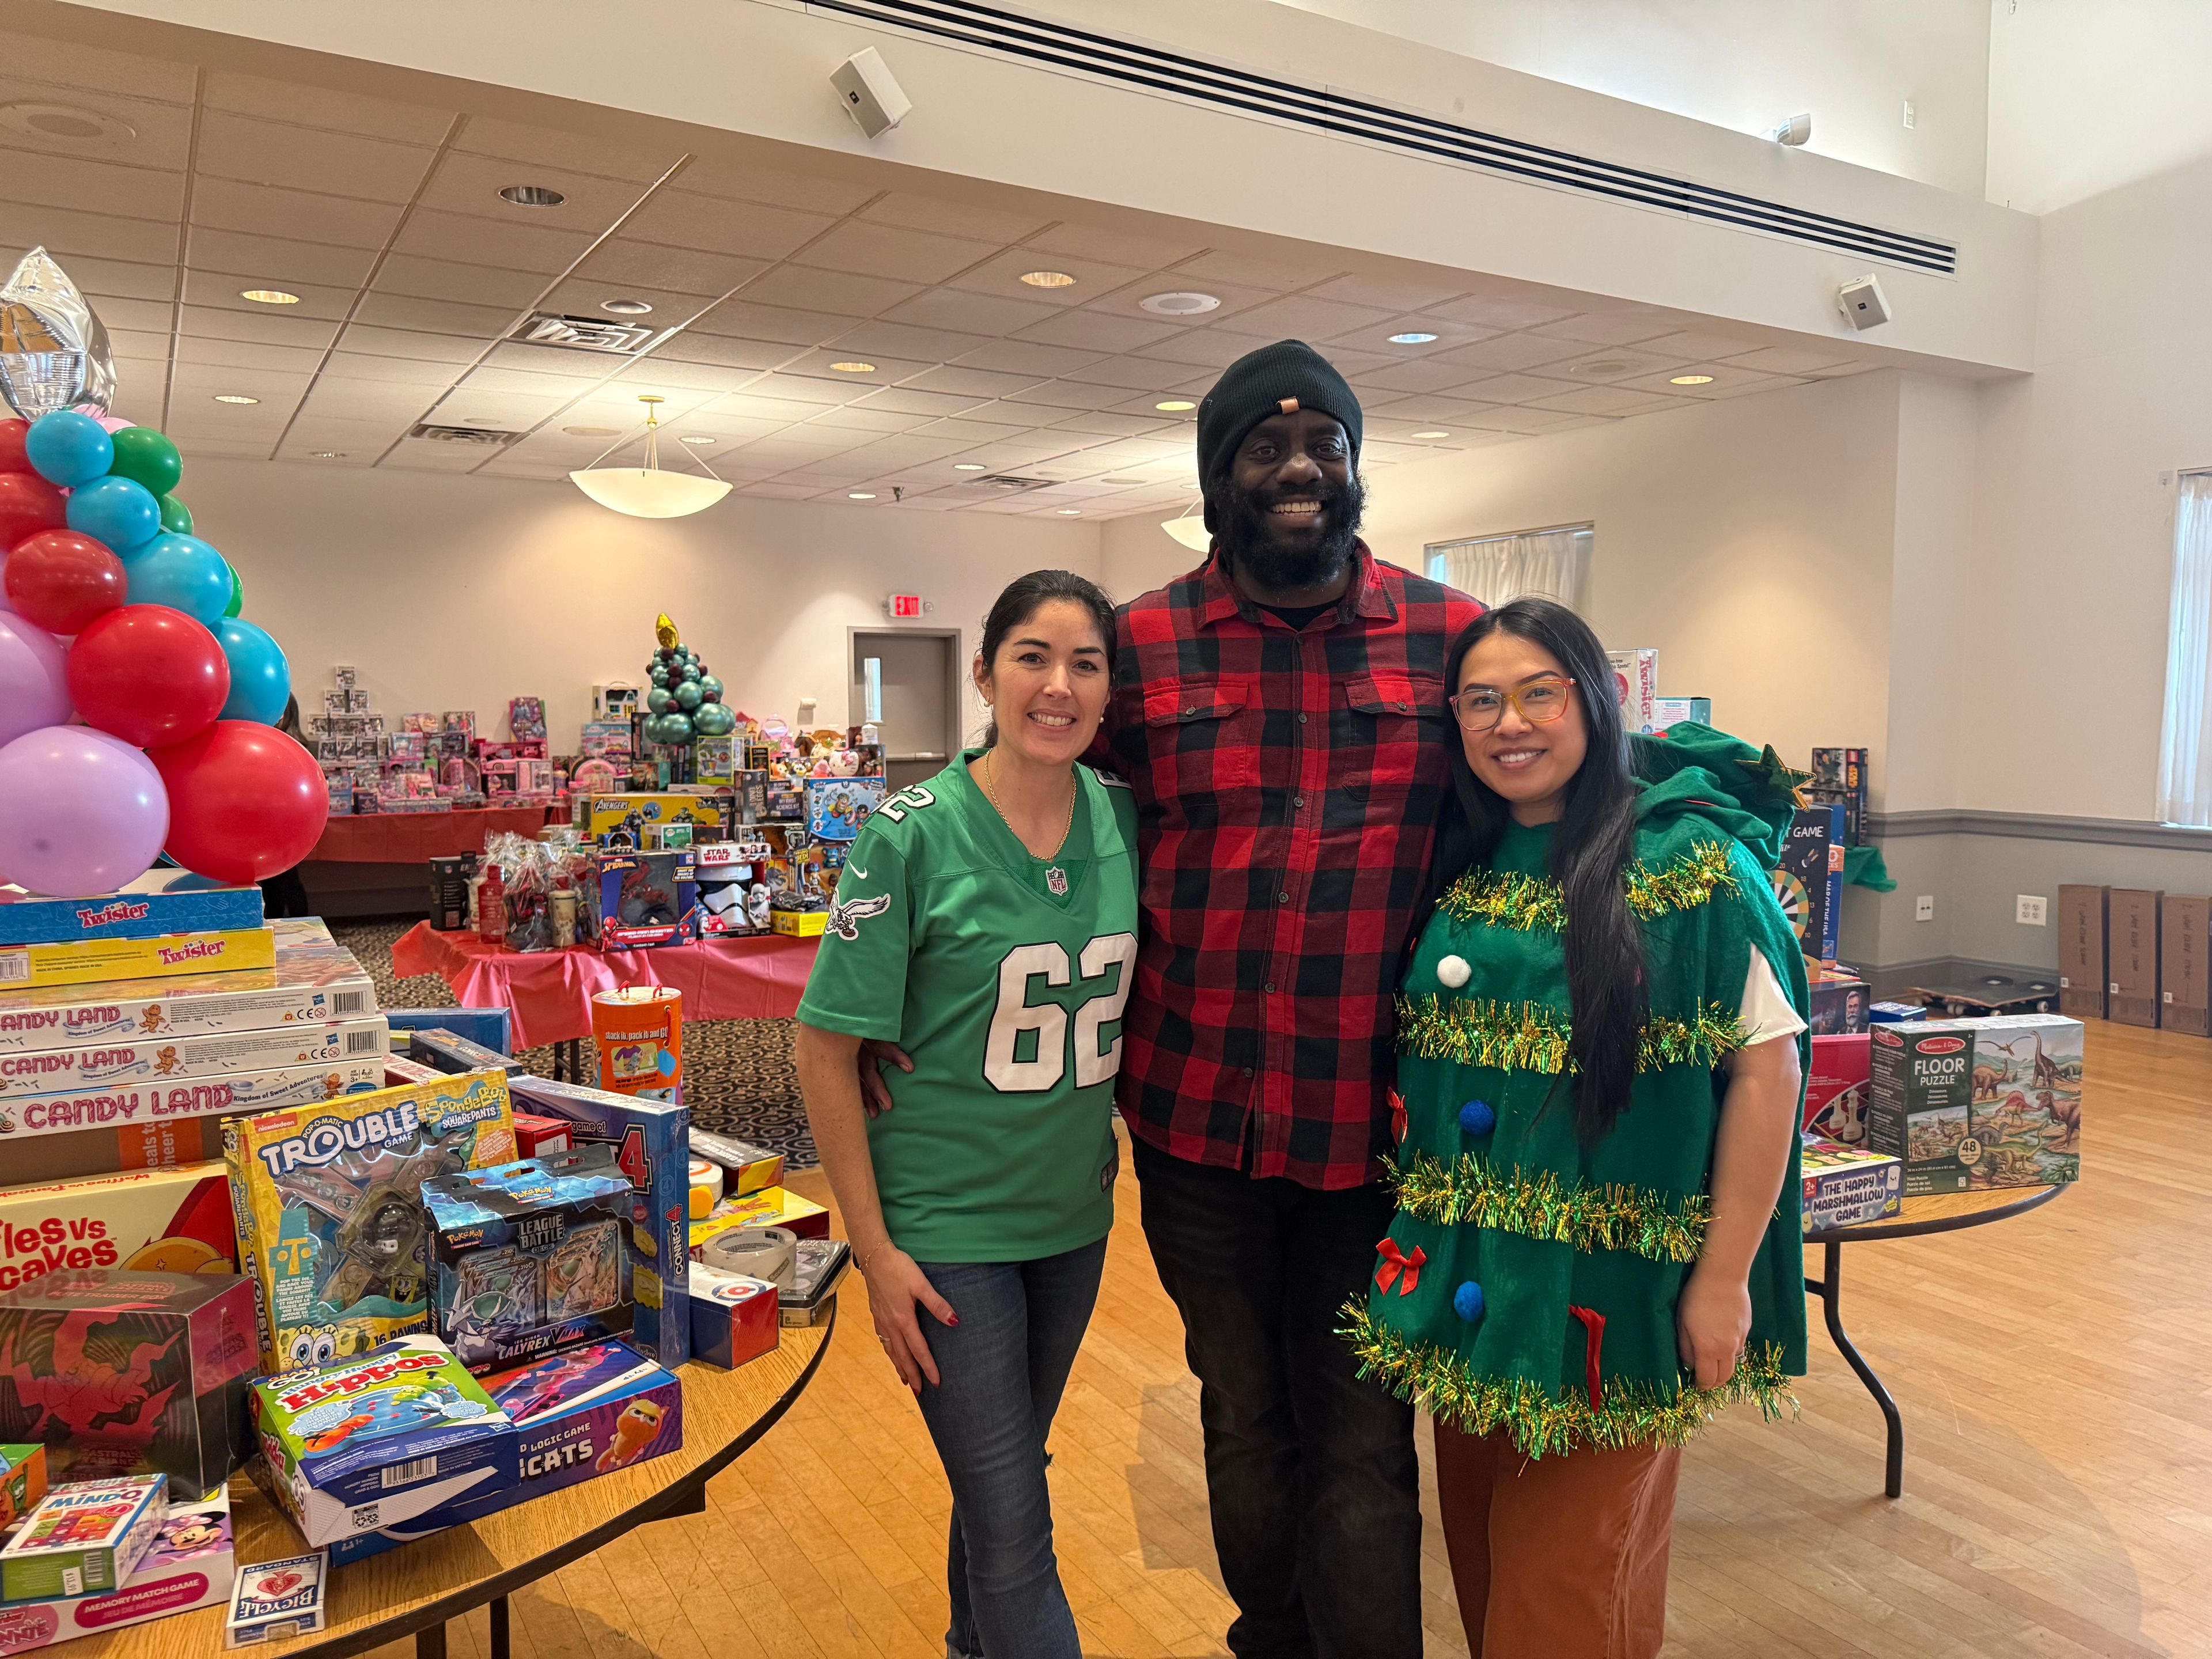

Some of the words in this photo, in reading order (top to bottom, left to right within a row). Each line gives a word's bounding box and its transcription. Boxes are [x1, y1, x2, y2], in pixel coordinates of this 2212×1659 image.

[895, 596, 919, 616] EXIT
[1639, 656, 1652, 719] Twister
[594, 799, 630, 813] AVENGERS
[1793, 826, 1824, 838] GAME
[1051, 879, 1066, 891] NFL
[1825, 897, 1830, 907] OF
[78, 902, 149, 928] Twister
[158, 940, 226, 965] Twister
[1, 1010, 59, 1031] ANDY
[67, 1006, 120, 1025] LAND
[983, 931, 1138, 1093] 62
[93, 1024, 105, 1033] Sweet
[106, 1018, 131, 1029] Adventures
[628, 1032, 642, 1041] pack
[650, 1029, 660, 1039] and
[1, 1054, 74, 1075] CANDY
[82, 1048, 135, 1069] LAND
[108, 1067, 120, 1075] Sweet
[121, 1060, 145, 1071] Adventures
[1915, 1058, 1965, 1075] FLOOR
[1921, 1075, 1955, 1086] PUZZLE
[24, 1093, 138, 1129] CANDY
[151, 1084, 232, 1115] LAND
[233, 1091, 261, 1103] Kingdom
[262, 1091, 268, 1100] of
[270, 1085, 289, 1097] Sweet
[290, 1074, 324, 1089] Adventures
[425, 1087, 507, 1124] SpongeBob
[259, 1120, 295, 1132] nickelodeon
[442, 1107, 497, 1128] SQUAREPANTS
[573, 1123, 596, 1133] game
[596, 1121, 607, 1133] of
[303, 1117, 343, 1139] POP-O-MATIC
[262, 1102, 419, 1175] TROUBLE
[384, 1134, 413, 1148] GAME
[1962, 1141, 1976, 1152] 48
[618, 1131, 648, 1188] 4
[86, 1174, 150, 1187] Waffles
[1806, 1181, 1815, 1191] 2+
[1824, 1183, 1841, 1196] THE
[1844, 1176, 1875, 1192] HAPPY
[0, 1185, 66, 1198] Pancak
[509, 1187, 552, 1200] Pokémon
[1813, 1187, 1884, 1213] MARSHMALLOW
[233, 1185, 244, 1237] SQUAREPANTS
[666, 1205, 682, 1222] 4
[1836, 1206, 1862, 1222] GAME
[520, 1214, 563, 1236] LEAGUE
[0, 1218, 67, 1259] les
[69, 1217, 107, 1241] vs
[447, 1228, 484, 1244] Pokémon
[520, 1226, 565, 1249] BATTLE
[534, 1244, 553, 1253] DECK
[672, 1221, 684, 1276] CONNECT
[0, 1240, 118, 1291] cakes
[246, 1251, 272, 1353] TROUBLE
[374, 1334, 387, 1347] 16
[390, 1320, 427, 1340] PAWNS
[498, 1335, 551, 1360] CALYREX
[550, 1324, 586, 1344] VMAX
[535, 1349, 558, 1360] WARNING:
[635, 1346, 656, 1358] Hasbro
[267, 1368, 320, 1390] GO!
[268, 1369, 308, 1382] GRAB
[281, 1354, 447, 1410] Hippos
[283, 1372, 343, 1396] Hungry
[345, 1353, 398, 1374] Hungry
[531, 1433, 562, 1452] LOGIC
[564, 1422, 591, 1438] GAME
[246, 1556, 319, 1573] STANDARD
[85, 1596, 131, 1613] MEMORY
[132, 1587, 169, 1601] MATCH
[169, 1579, 199, 1592] GAME
[239, 1587, 314, 1618] BICYCLE
[103, 1609, 120, 1619] JEU
[120, 1606, 134, 1614] DE
